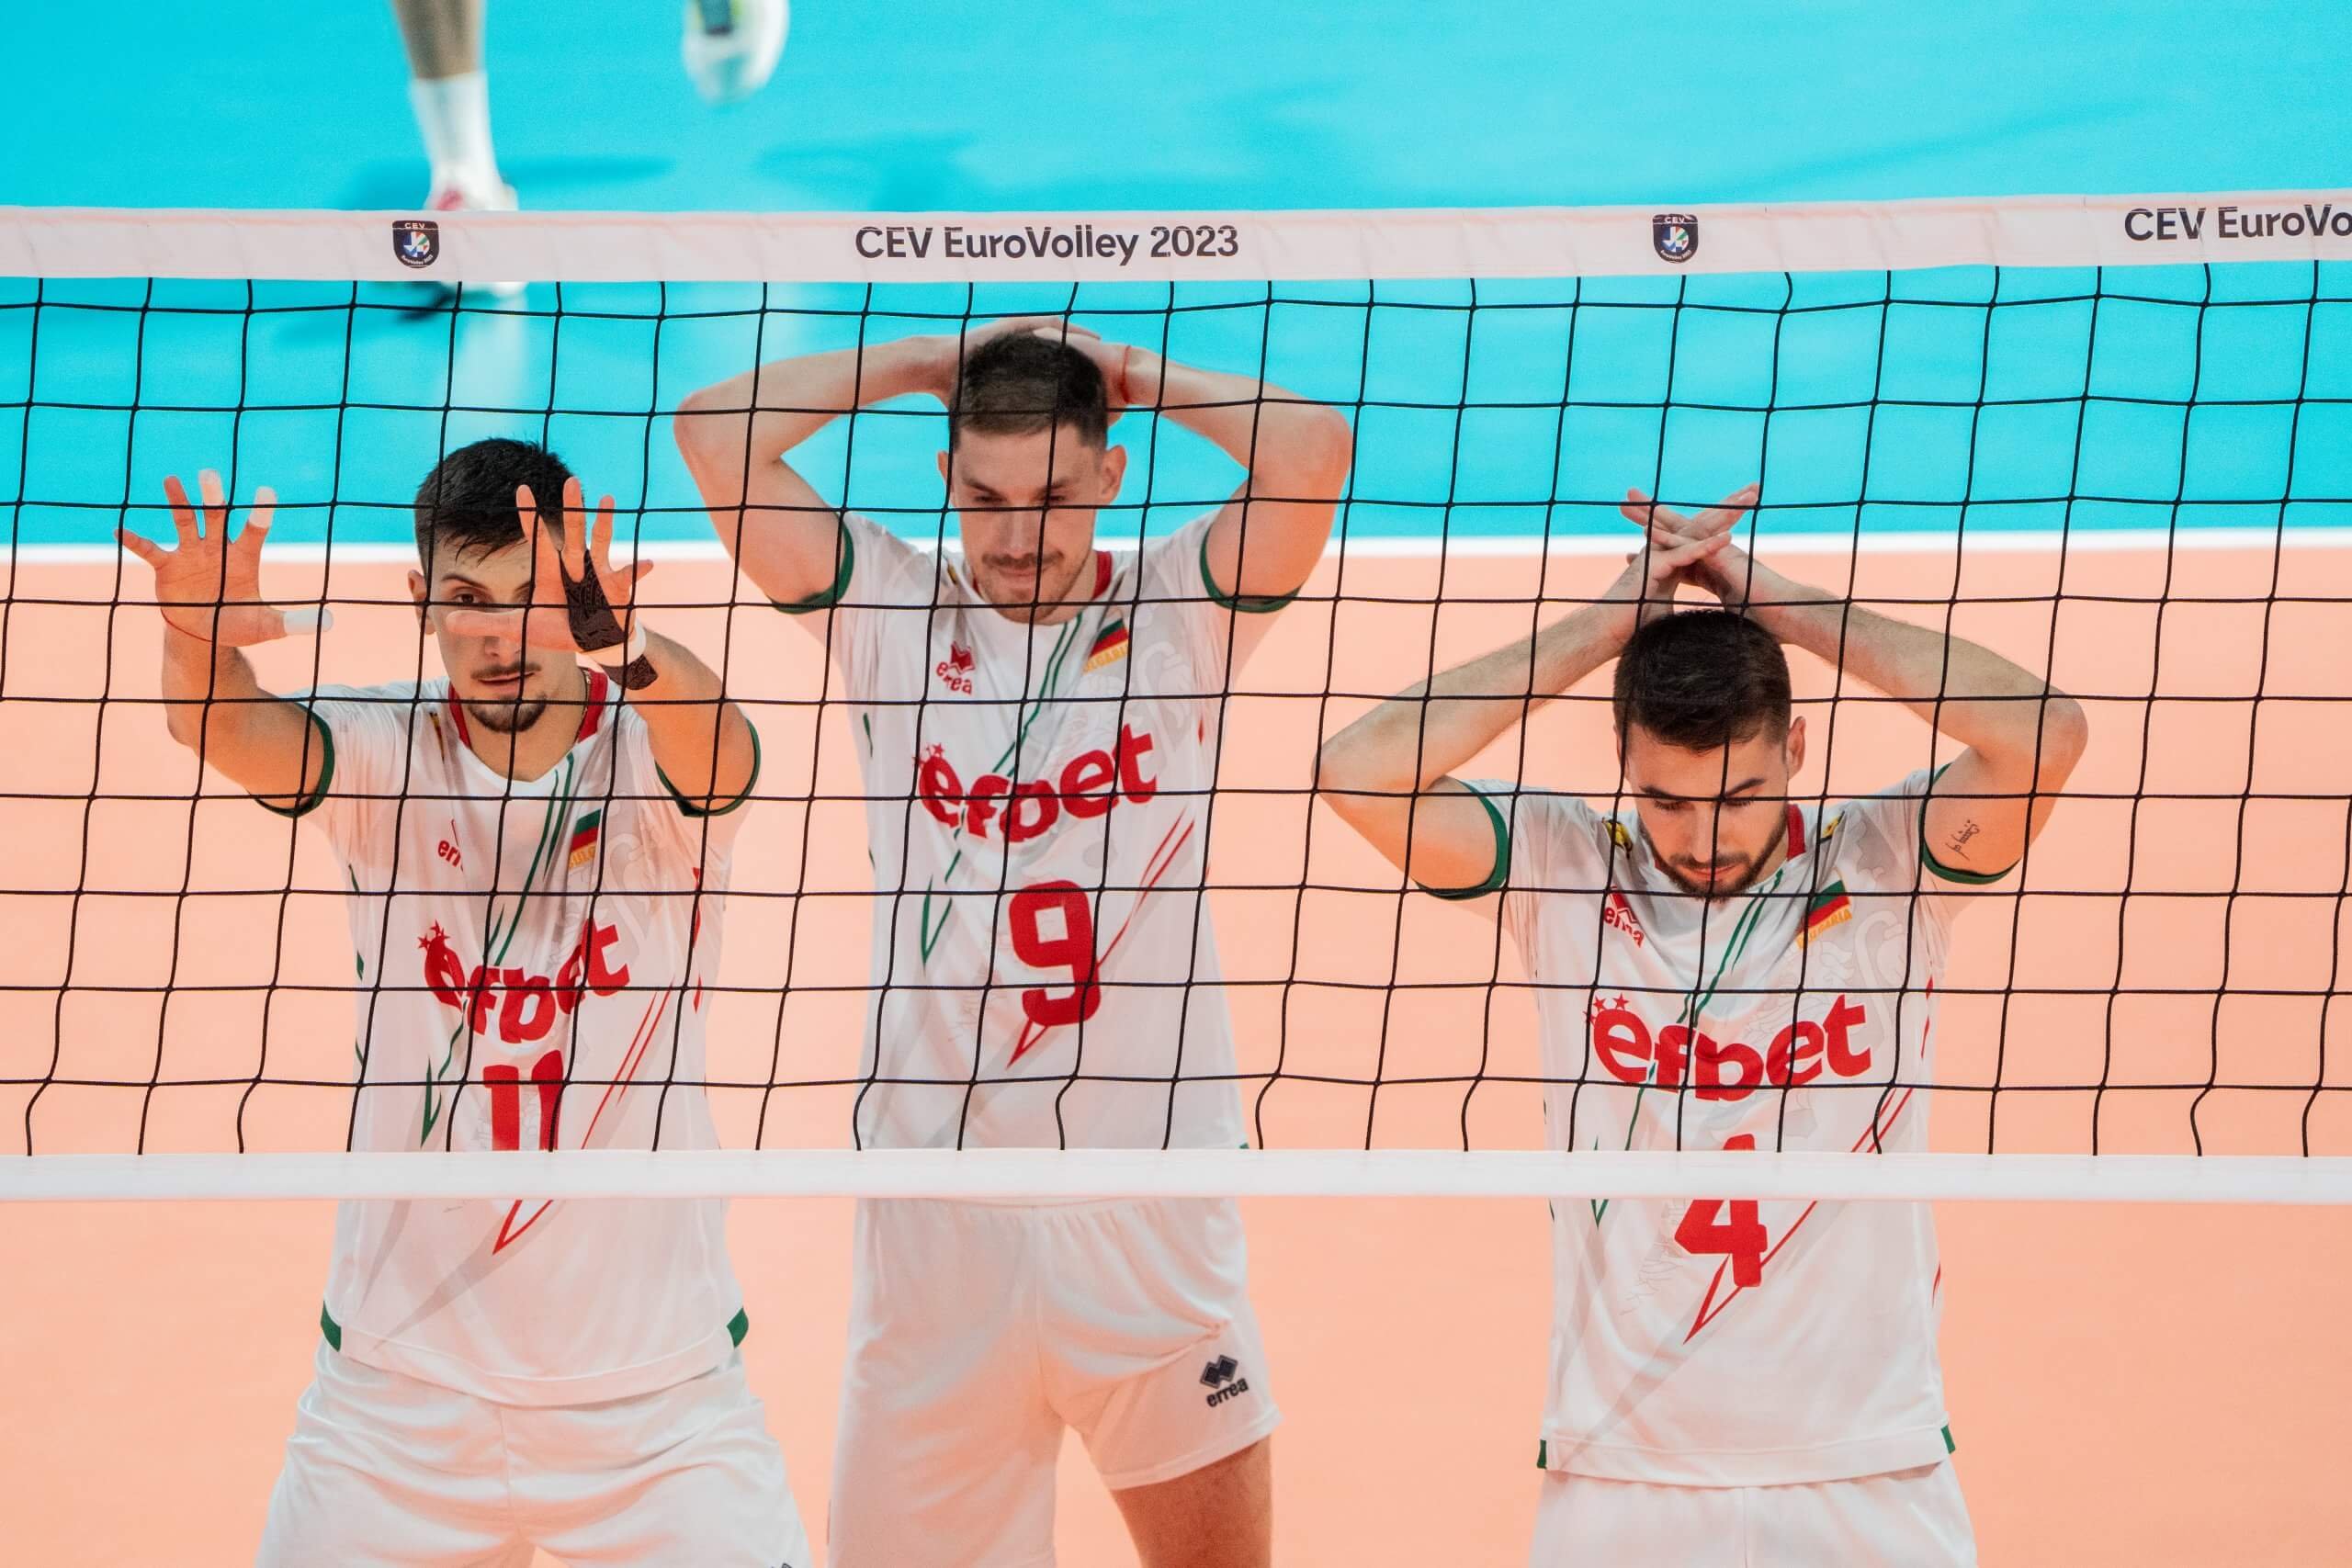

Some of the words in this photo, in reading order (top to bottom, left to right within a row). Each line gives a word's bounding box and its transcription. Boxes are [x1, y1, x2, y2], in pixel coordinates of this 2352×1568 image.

[855, 226, 933, 259] CEV
[944, 224, 1139, 266] EuroVolley
[1150, 225, 1238, 258] 2023
[2124, 208, 2206, 242] CEV
[2218, 204, 2352, 238] EuroVo
[918, 723, 1158, 843] efbet
[1008, 879, 1102, 1027] 9
[482, 1049, 564, 1150] 11
[1592, 994, 1872, 1102] efbet
[1673, 1133, 1769, 1288] 4
[1206, 1378, 1249, 1407] errea
